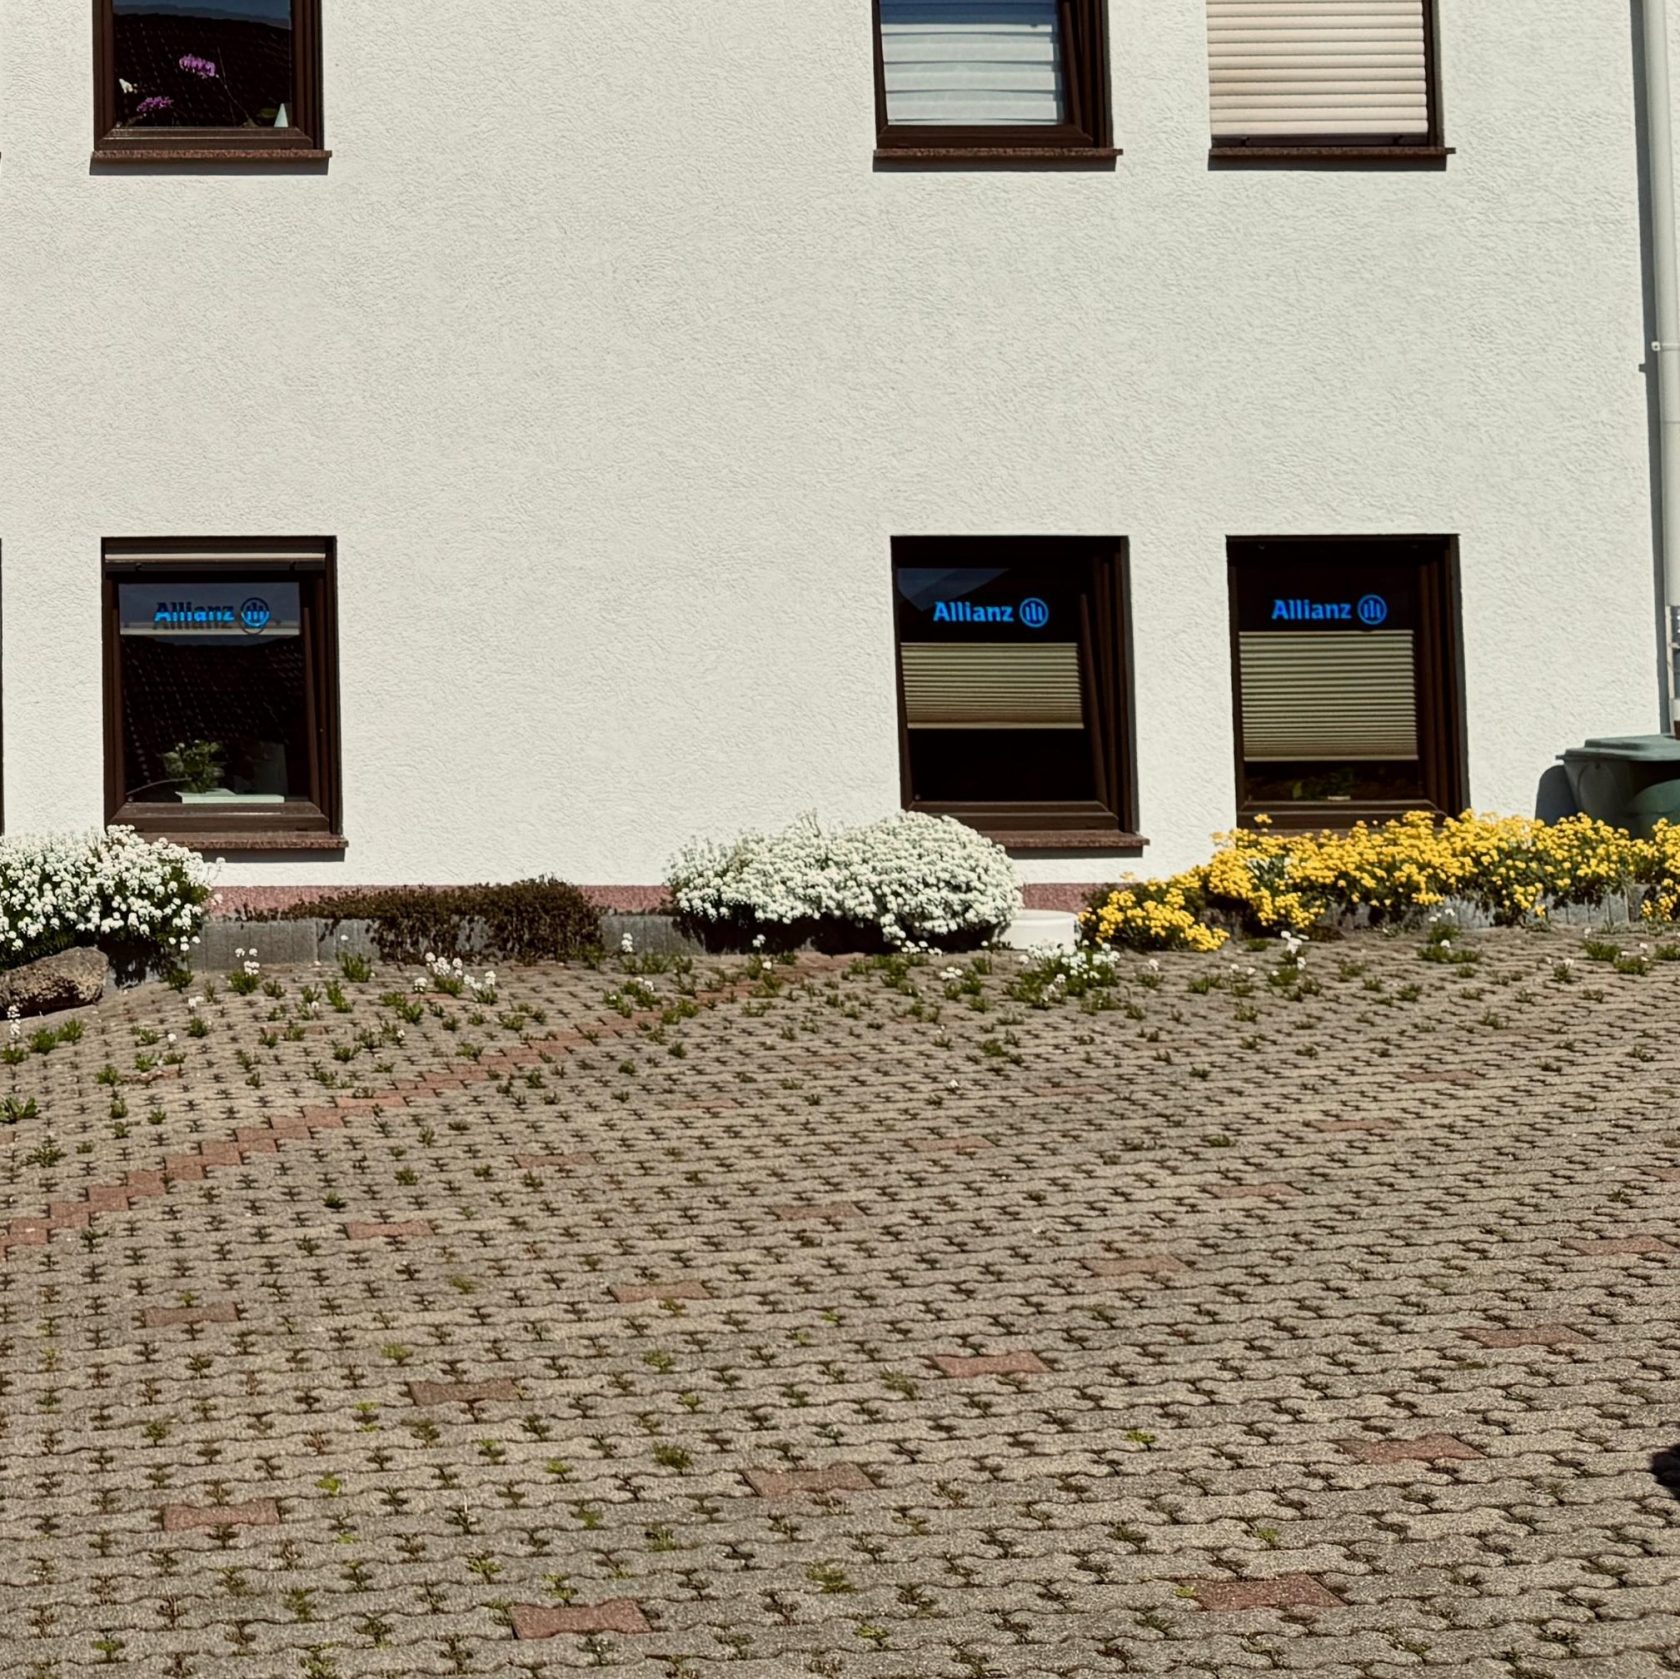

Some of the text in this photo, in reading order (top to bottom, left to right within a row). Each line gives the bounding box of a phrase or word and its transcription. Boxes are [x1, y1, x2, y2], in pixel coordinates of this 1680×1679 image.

[154, 601, 235, 623] Allianz
[932, 600, 1015, 622] Allianz
[1271, 598, 1353, 620] Allianz
